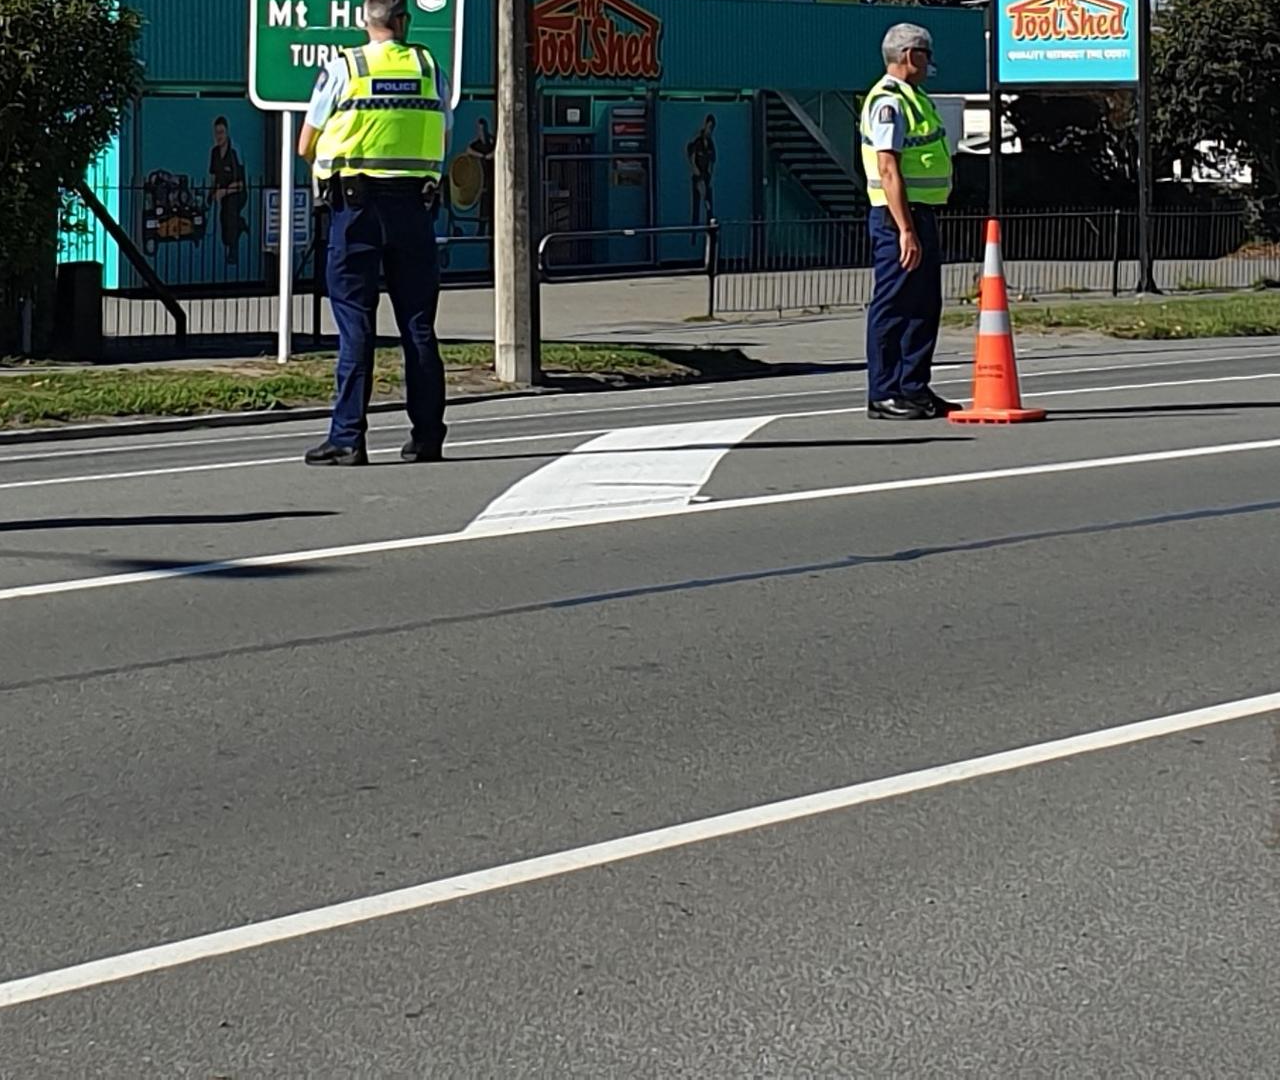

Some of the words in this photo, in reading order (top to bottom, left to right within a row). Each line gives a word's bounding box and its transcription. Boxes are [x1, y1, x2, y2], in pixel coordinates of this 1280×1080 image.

[269, 0, 308, 28] Mt
[1009, 7, 1061, 37] Tool
[1065, 4, 1125, 37] Shed
[590, 17, 660, 76] Shed
[375, 82, 417, 91] POLICE
